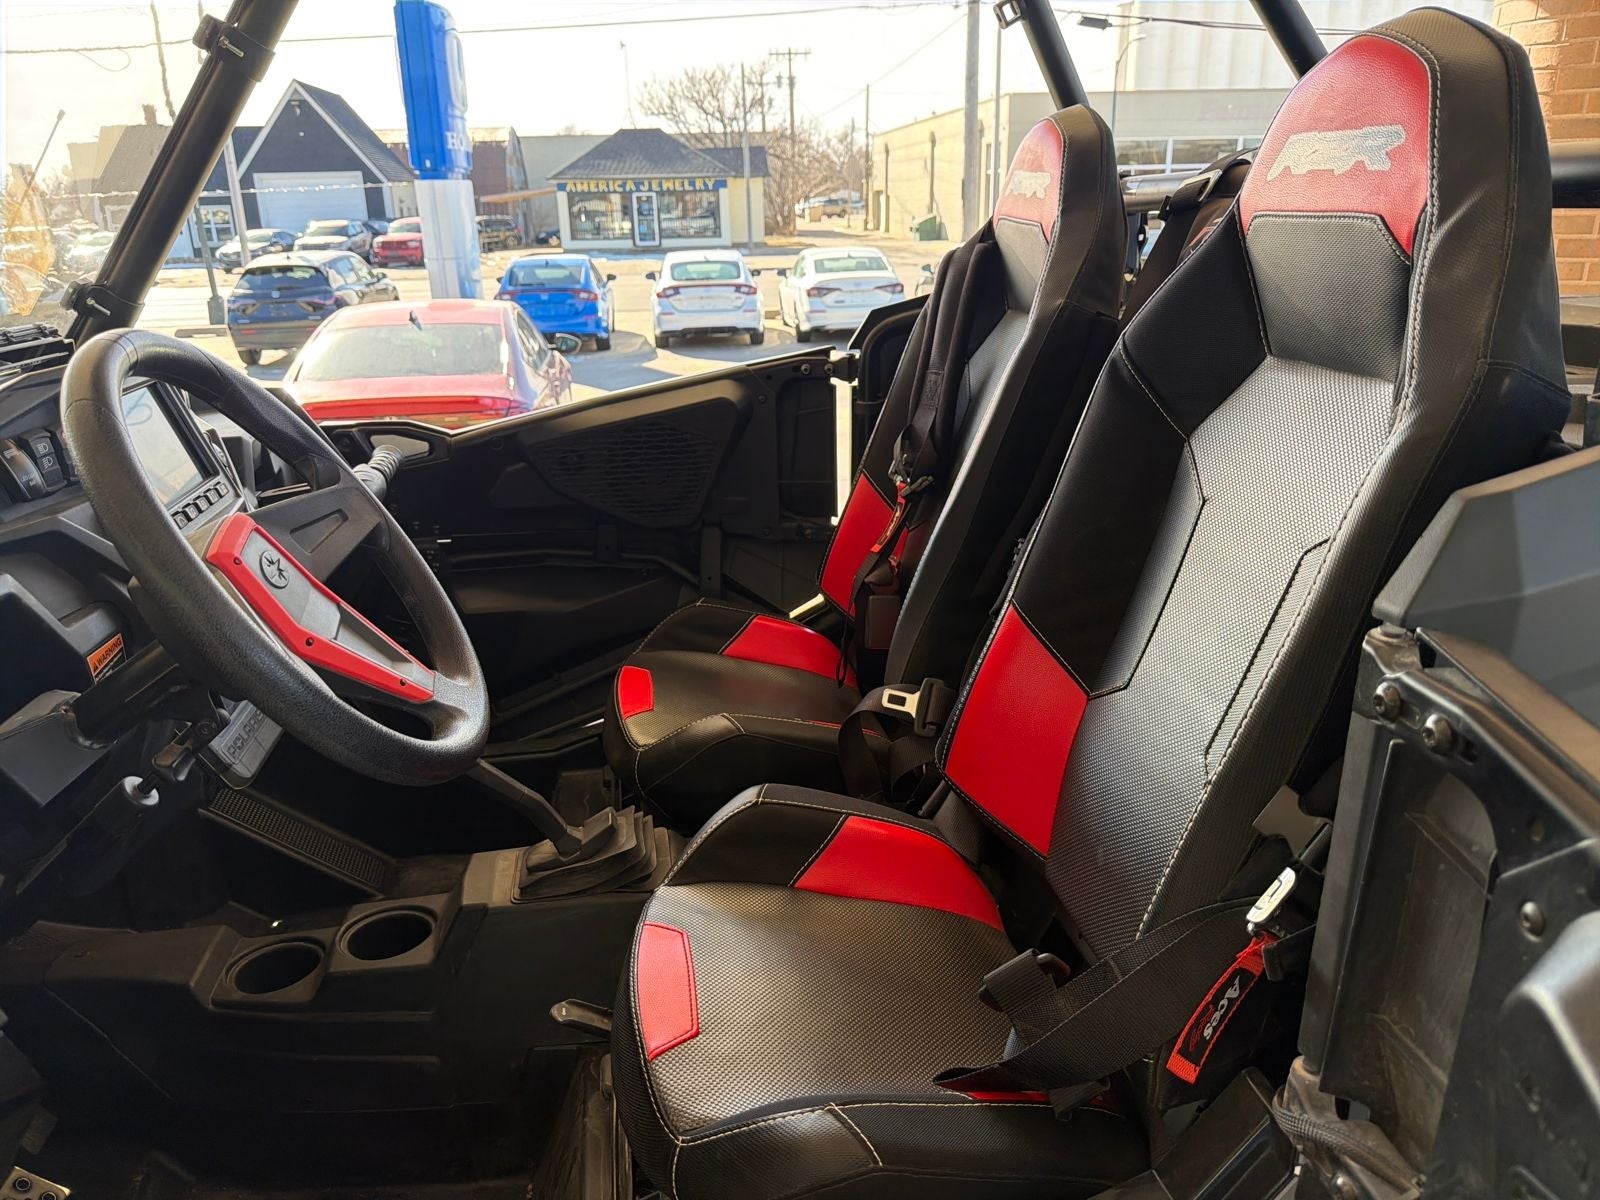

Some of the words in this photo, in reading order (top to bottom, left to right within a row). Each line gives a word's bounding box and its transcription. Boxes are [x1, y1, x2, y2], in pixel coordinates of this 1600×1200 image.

[565, 179, 636, 192] AMERICA
[639, 177, 715, 192] JEWELRY
[96, 637, 122, 667] WARNING
[1203, 975, 1240, 1040] Aces
